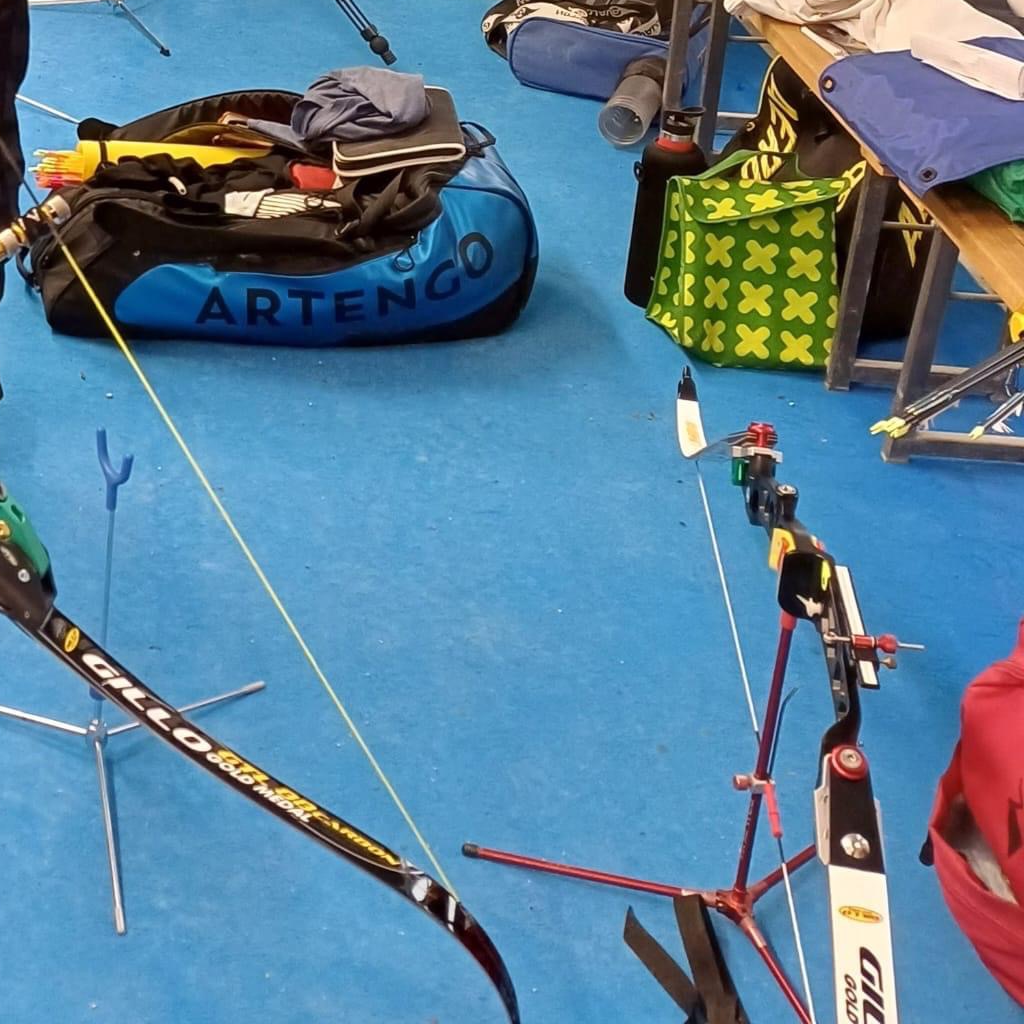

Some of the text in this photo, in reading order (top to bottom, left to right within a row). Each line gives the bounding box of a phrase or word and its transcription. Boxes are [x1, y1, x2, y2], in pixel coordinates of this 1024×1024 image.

[195, 232, 494, 326] ARTENGO
[81, 653, 212, 753] GILLO
[206, 752, 311, 824] GOLD MEDAL
